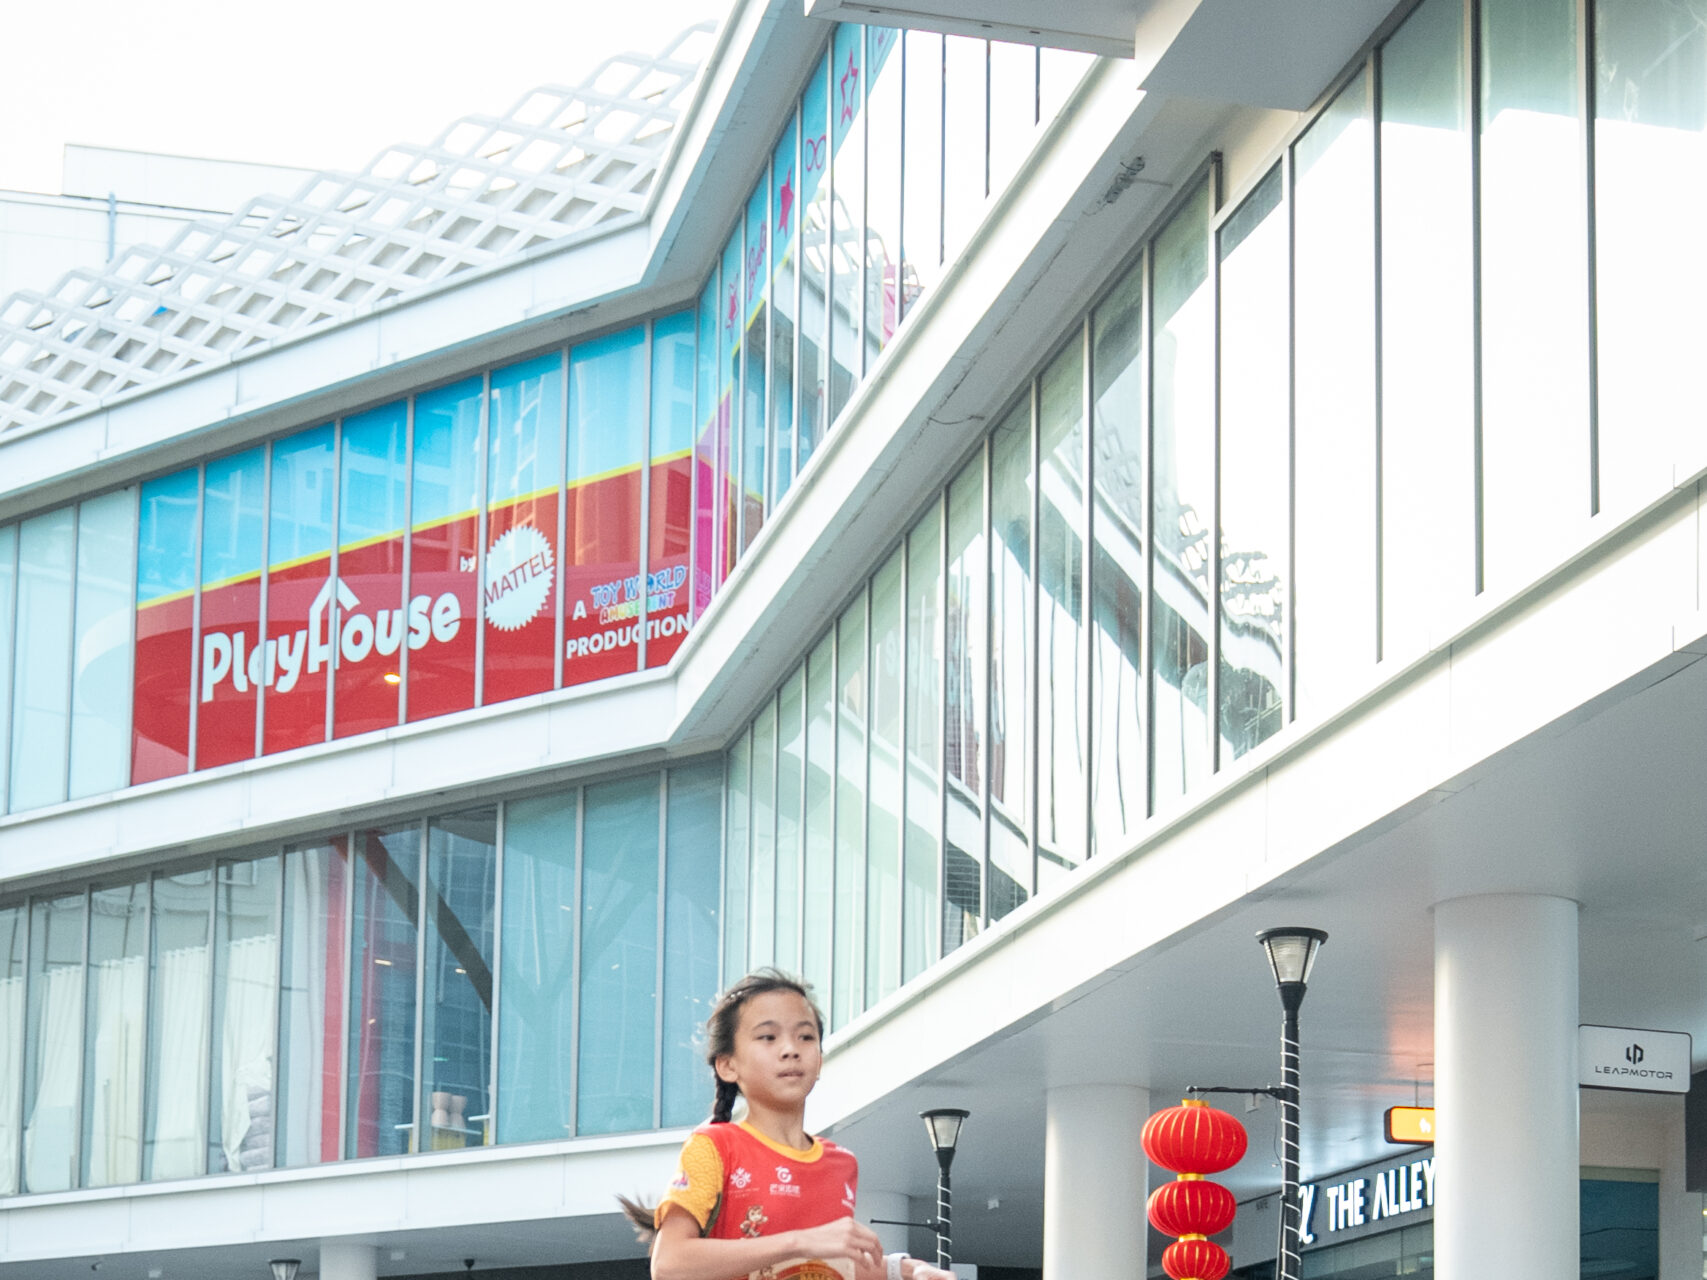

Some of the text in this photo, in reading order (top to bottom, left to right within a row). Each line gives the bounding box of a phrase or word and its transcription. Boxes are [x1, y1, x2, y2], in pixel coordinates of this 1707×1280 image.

[460, 554, 477, 574] by
[484, 551, 554, 605] MATTEL
[590, 579, 622, 609] TOY
[624, 564, 687, 600] WORLD
[572, 599, 588, 622] A
[566, 610, 692, 660] PRODUCTION
[1594, 1065, 1673, 1080] LEAPMOTOR
[1326, 1156, 1437, 1232] THE ALLEY
